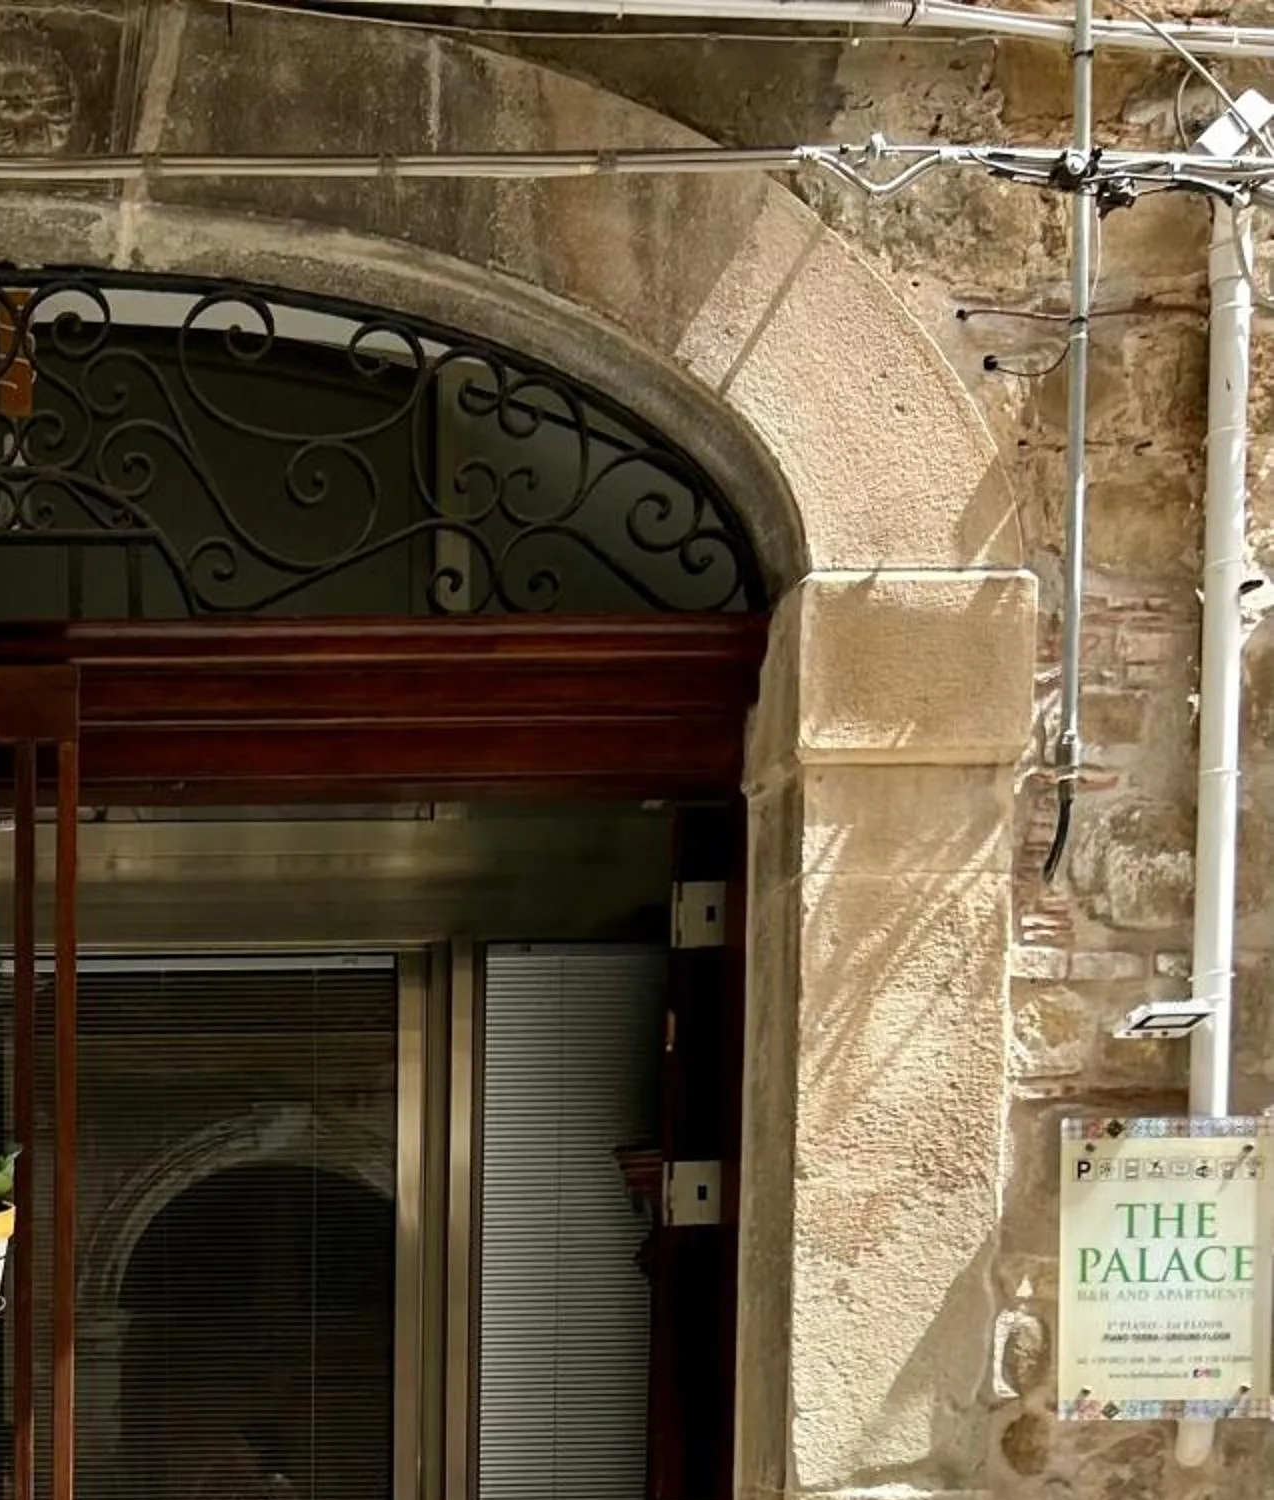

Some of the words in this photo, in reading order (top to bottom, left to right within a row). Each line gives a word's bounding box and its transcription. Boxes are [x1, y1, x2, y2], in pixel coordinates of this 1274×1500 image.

[1115, 1202, 1218, 1239] THE
[1077, 1246, 1255, 1283] PALACE
[1116, 1289, 1149, 1301] AND
